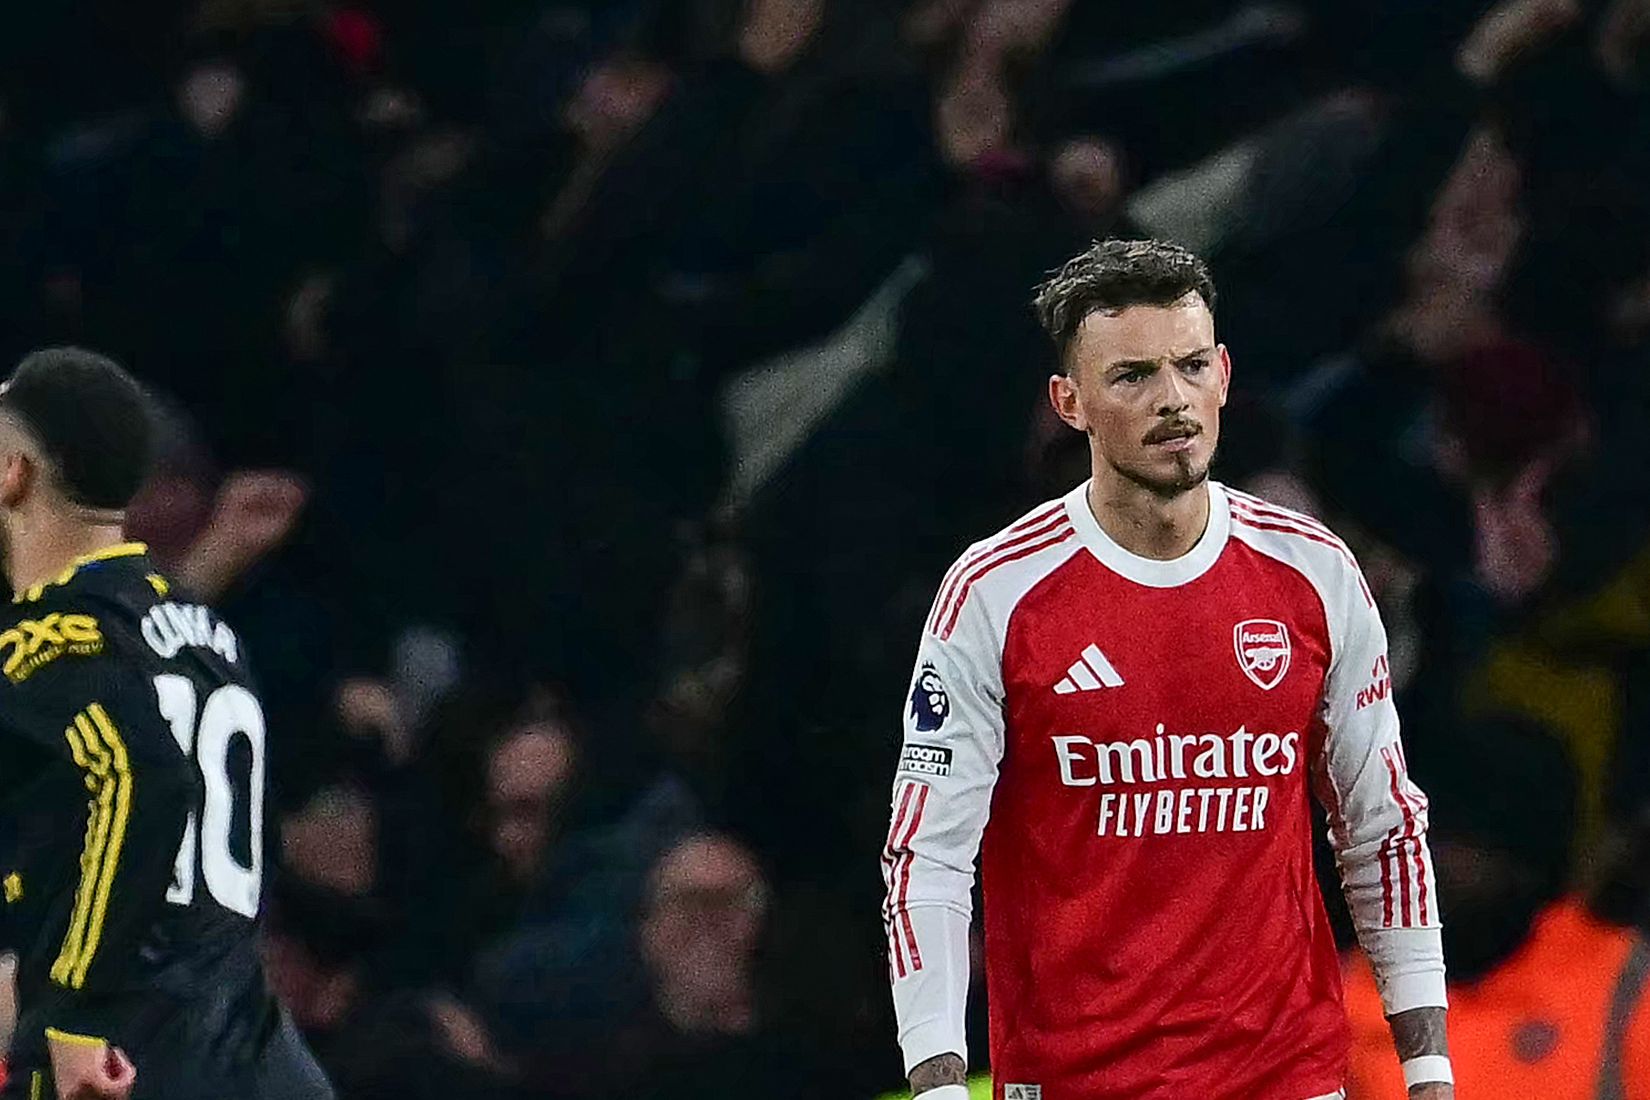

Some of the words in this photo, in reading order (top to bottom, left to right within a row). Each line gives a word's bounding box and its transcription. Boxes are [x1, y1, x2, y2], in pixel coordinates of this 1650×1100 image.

[1052, 723, 1298, 787] Emirates
[153, 673, 267, 919] 10
[1097, 791, 1150, 838] FLY
[1154, 785, 1269, 834] BETTER
